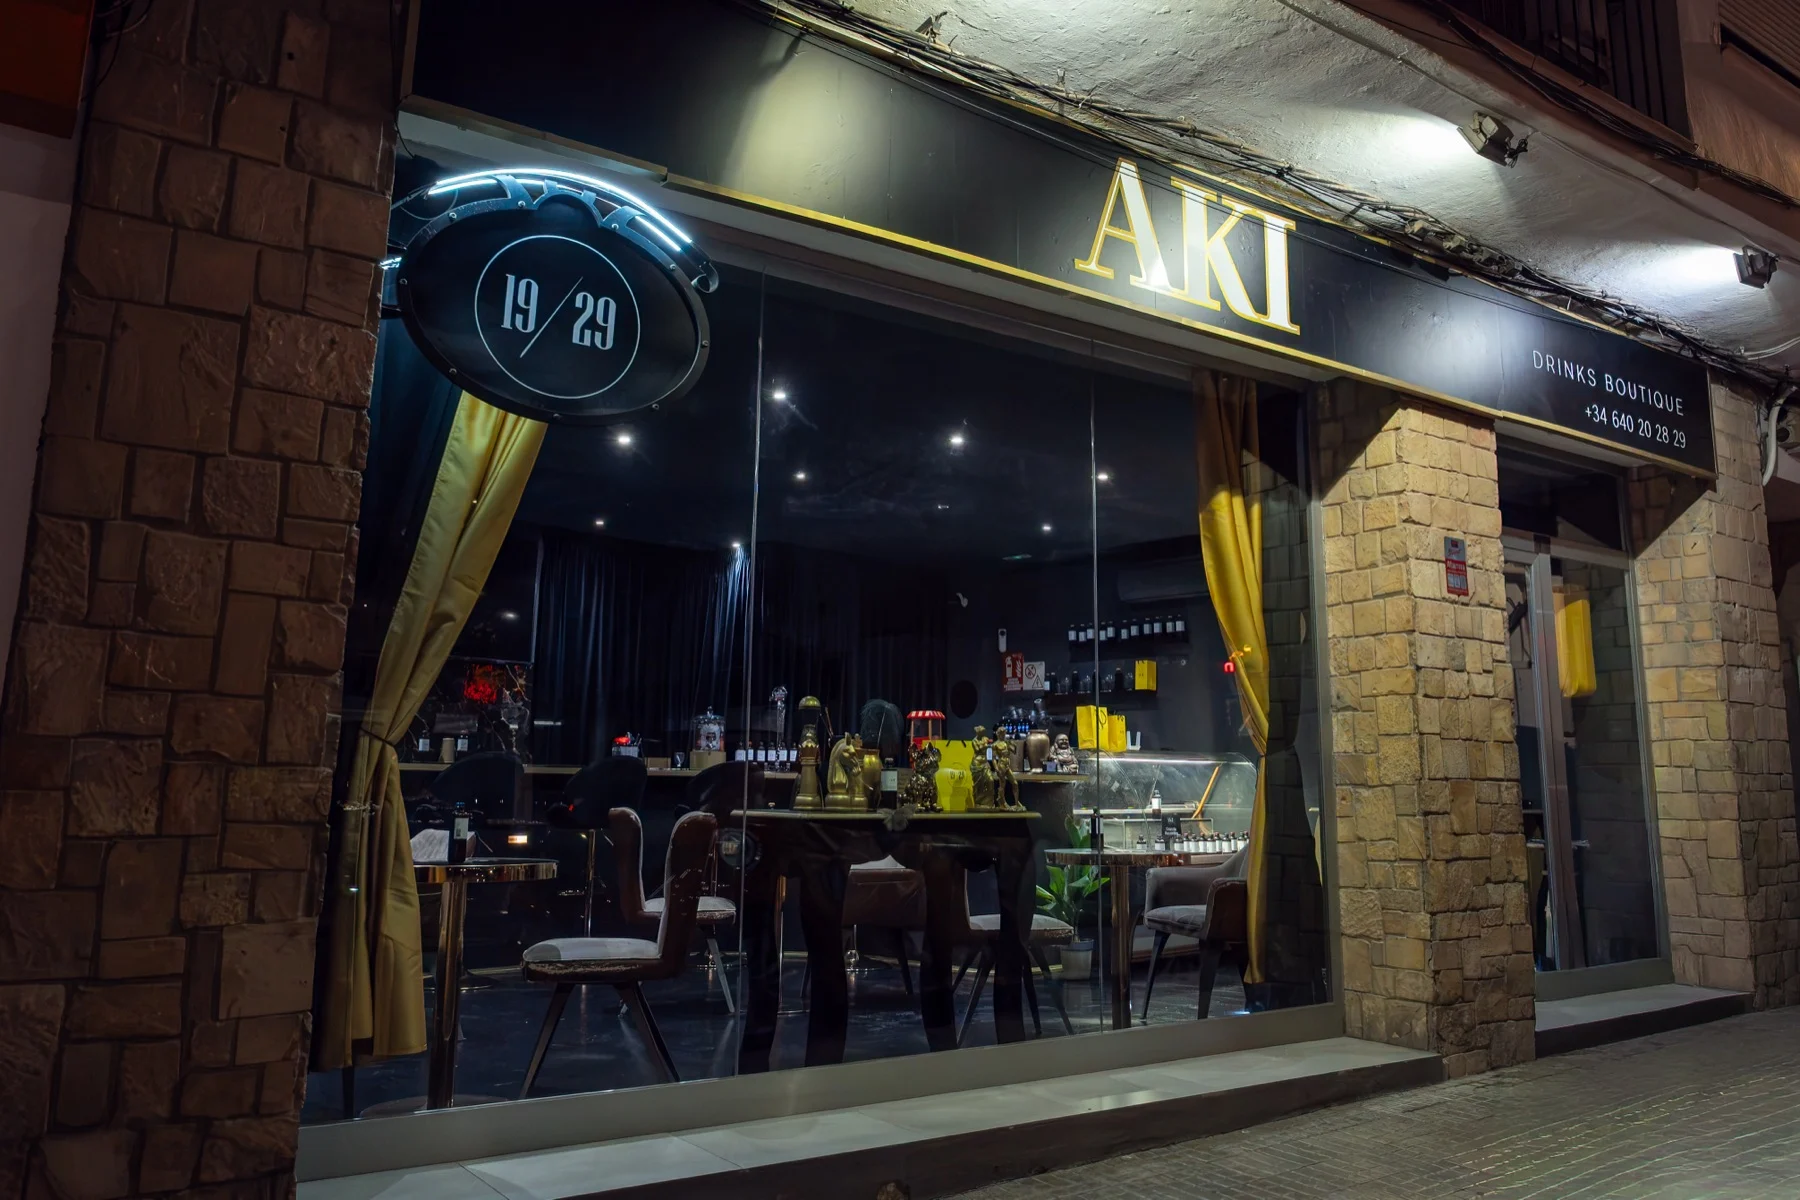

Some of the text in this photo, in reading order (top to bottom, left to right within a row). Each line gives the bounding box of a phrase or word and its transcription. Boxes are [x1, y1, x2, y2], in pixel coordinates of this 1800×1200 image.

[1074, 157, 1300, 335] AKI
[1532, 350, 1684, 416] DRINKS BOUTIQUE
[1585, 404, 1686, 449] +34 640 20 28 29
